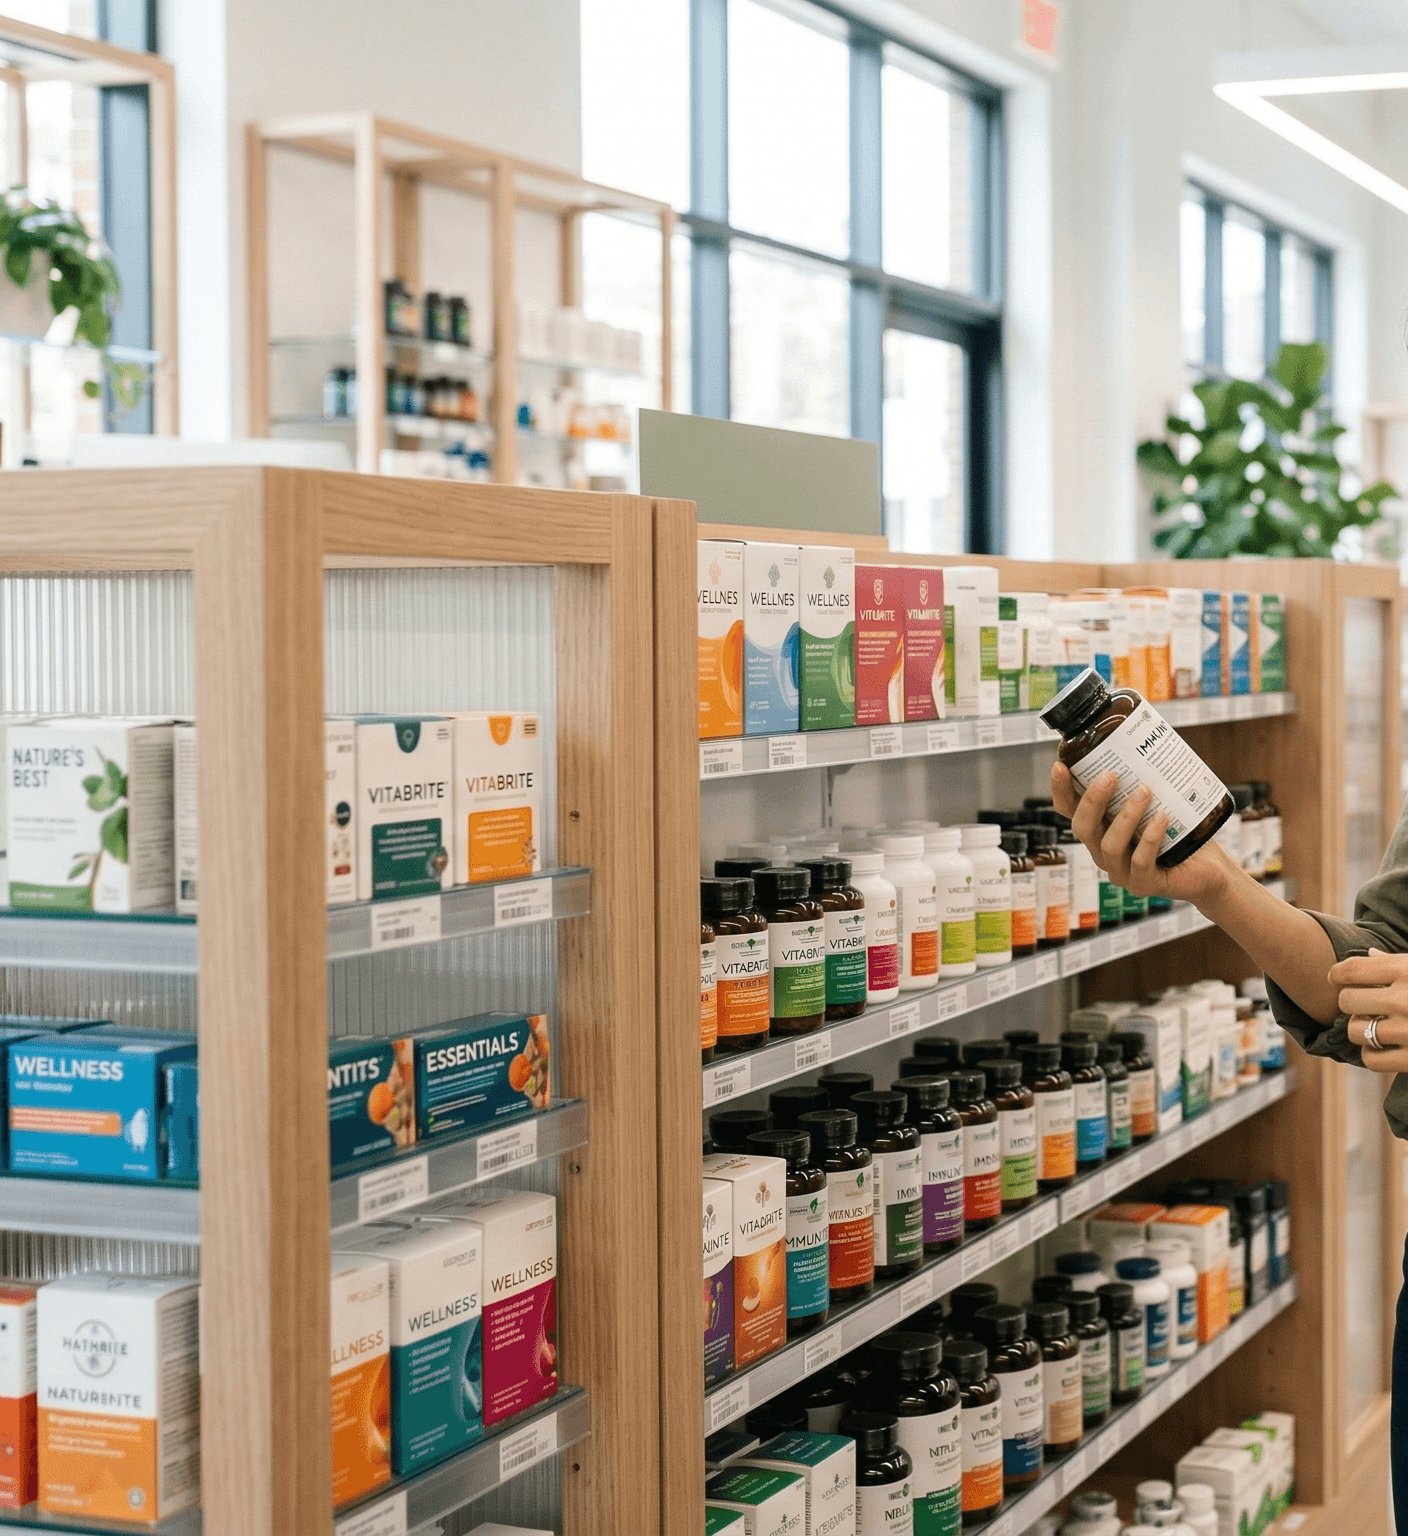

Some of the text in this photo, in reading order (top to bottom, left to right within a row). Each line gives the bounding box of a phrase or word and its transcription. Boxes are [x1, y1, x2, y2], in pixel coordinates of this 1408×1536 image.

[750, 591, 795, 607] WELLNES
[807, 593, 850, 608] WELLNES
[12, 746, 85, 768] NATURE'S
[12, 769, 49, 789] BEST
[465, 771, 534, 794] VITABRITE
[426, 1031, 519, 1074] ESSENTIALS
[14, 1054, 124, 1082] WELLNESS
[490, 1256, 554, 1294] WELLNESS
[408, 1293, 478, 1333] WELLNESS
[331, 1329, 384, 1367] LLNESS
